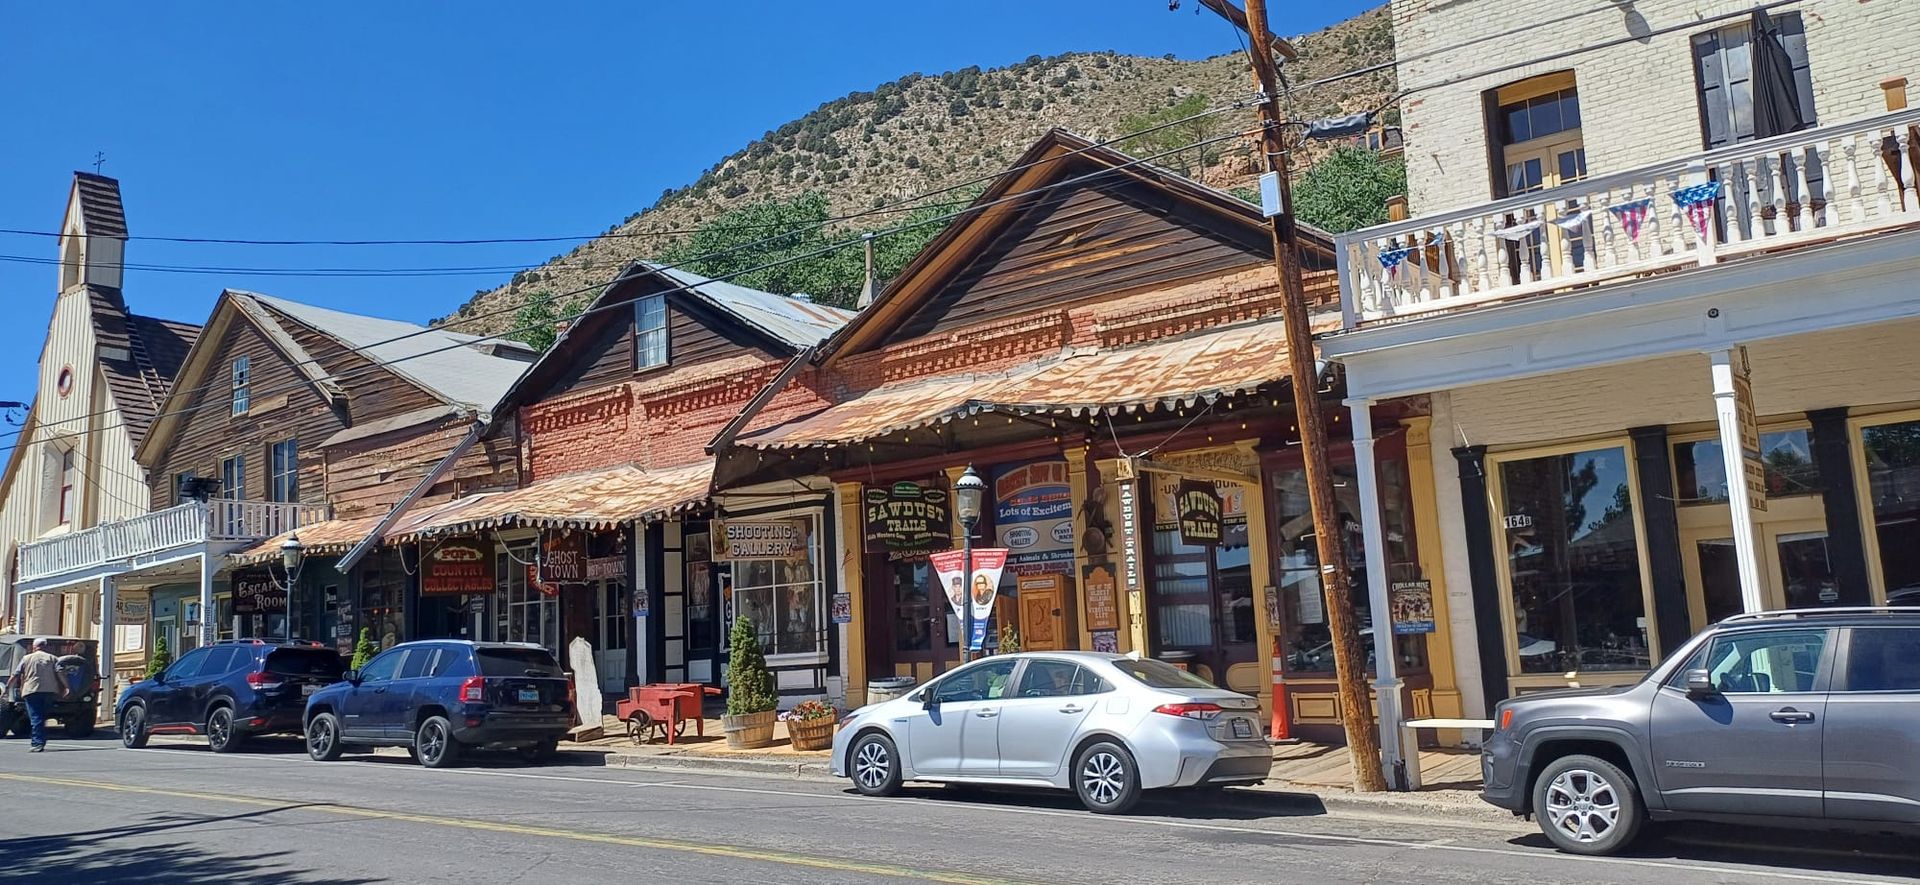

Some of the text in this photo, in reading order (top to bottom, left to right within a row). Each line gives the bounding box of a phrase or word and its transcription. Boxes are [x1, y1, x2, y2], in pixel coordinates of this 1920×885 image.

[868, 501, 945, 523] SAWDUST
[1000, 502, 1073, 518] Lots of Excitem
[1180, 490, 1219, 521] SAWDUST
[727, 524, 792, 540] SHOOTING
[887, 519, 928, 532] TRAILS
[1183, 520, 1219, 538] TRAILS
[732, 541, 793, 556] GALLERY
[549, 550, 578, 564] GHOST
[1125, 541, 1137, 585] TRAILS
[432, 564, 484, 576] COUNTRY
[549, 564, 579, 579] TOWN
[603, 560, 625, 576] TOWN
[424, 578, 493, 592] COLLECTABLES
[254, 594, 287, 611] ROOM
